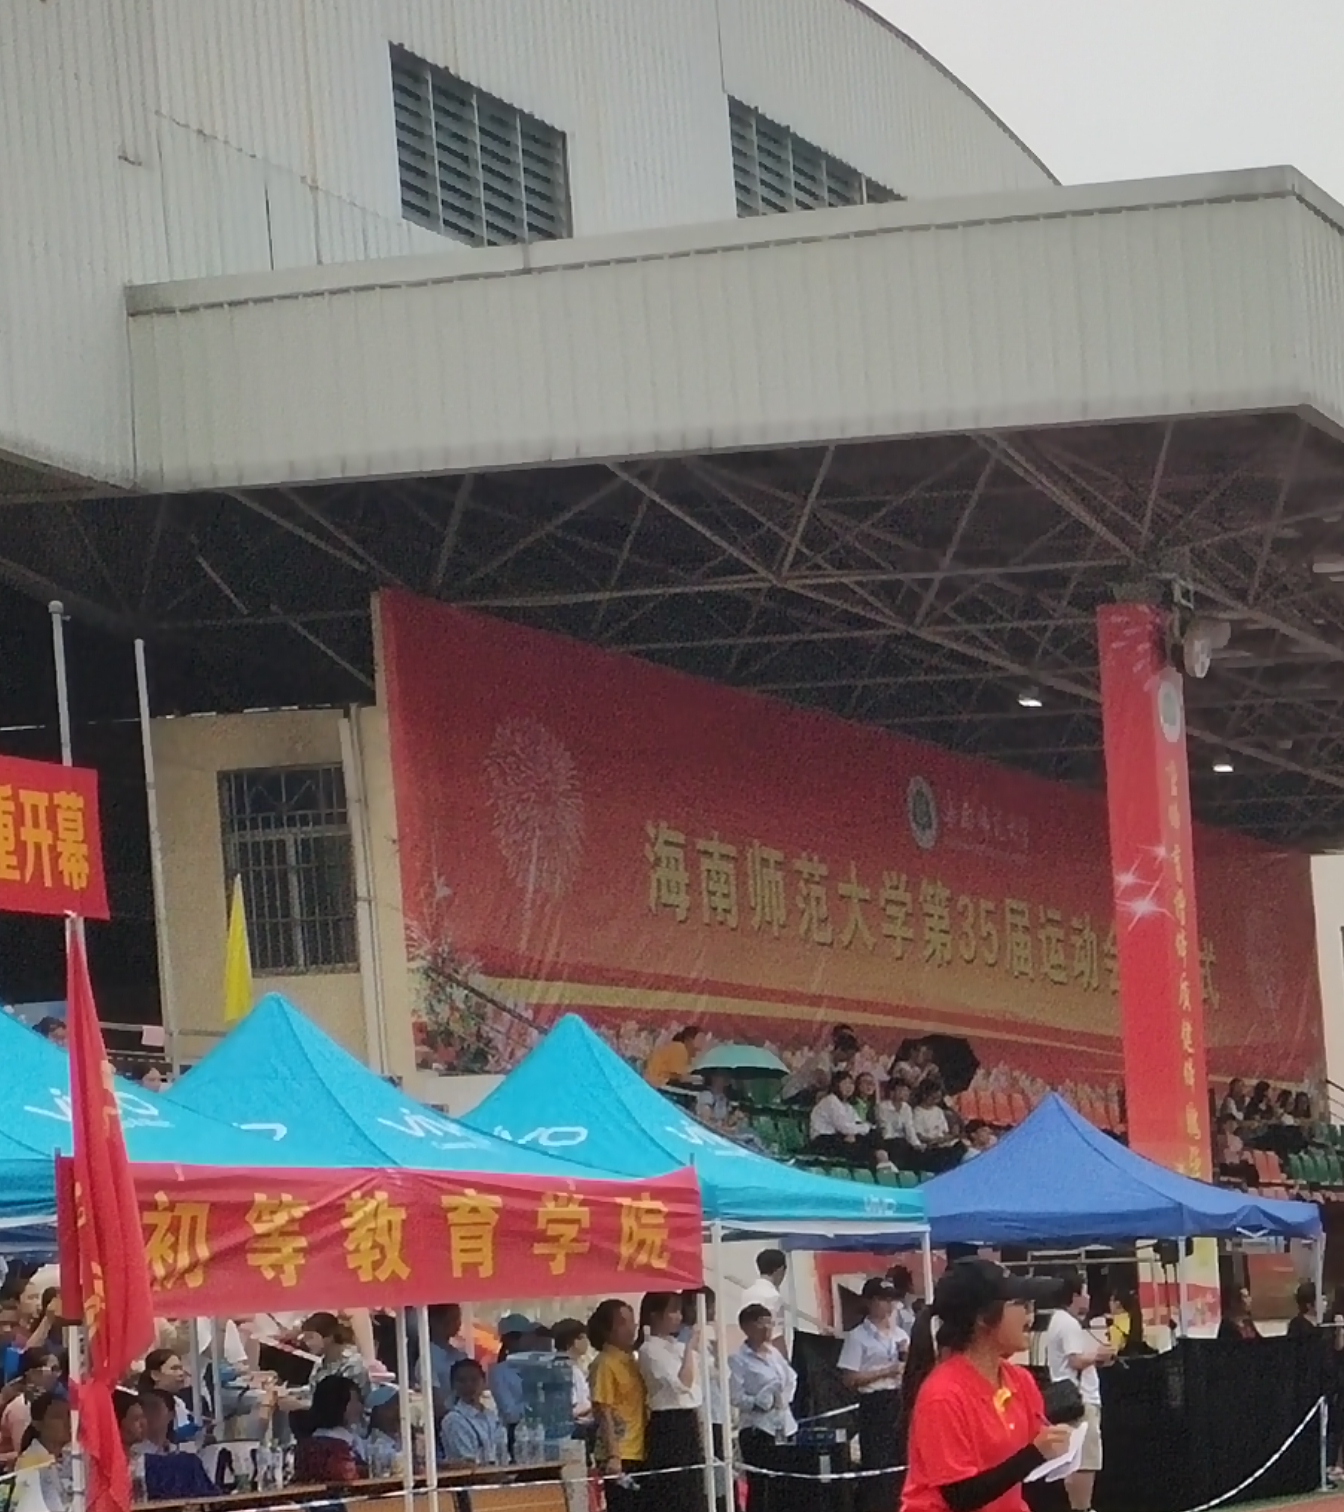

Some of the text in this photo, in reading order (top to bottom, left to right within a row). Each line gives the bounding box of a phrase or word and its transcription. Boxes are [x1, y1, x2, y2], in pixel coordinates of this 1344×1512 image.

[142, 1190, 669, 1290] 初等教育学院
